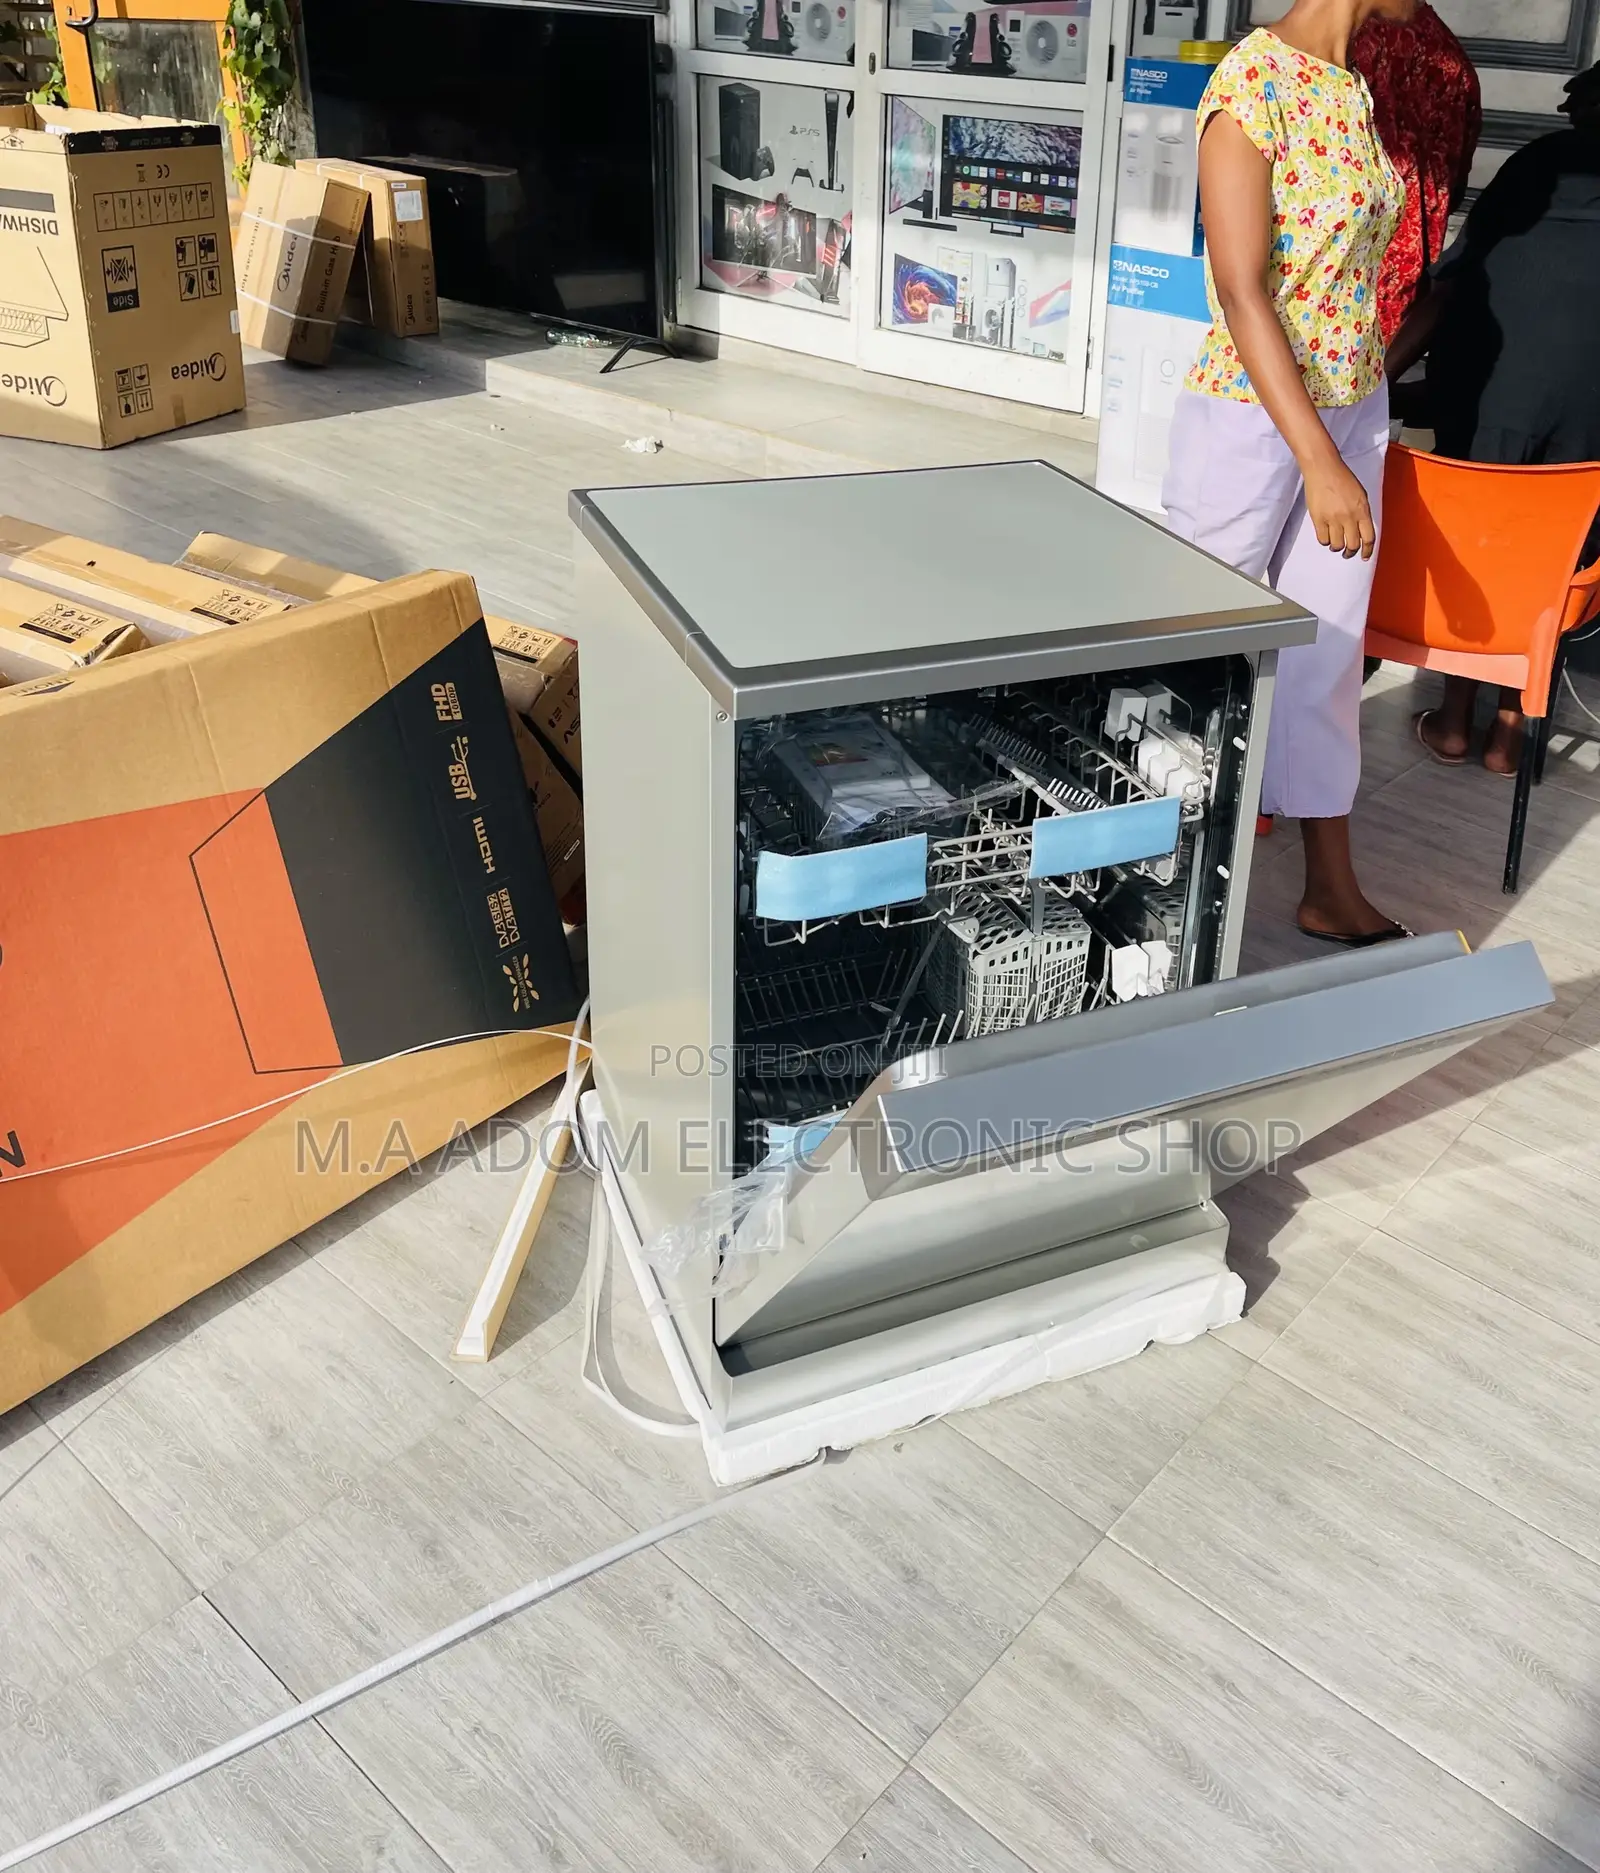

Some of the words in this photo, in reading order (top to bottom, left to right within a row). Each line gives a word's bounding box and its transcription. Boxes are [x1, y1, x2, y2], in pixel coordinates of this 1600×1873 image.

[1136, 69, 1168, 79] NASCO
[0, 214, 59, 236] DISHW
[316, 279, 330, 313] Built-in
[325, 257, 335, 276] Gas
[330, 235, 341, 256] Hb
[1122, 261, 1169, 279] NASCO
[113, 295, 134, 306] Side
[171, 352, 227, 382] Midea
[431, 683, 453, 721] FHD
[447, 685, 460, 716] 1080P
[448, 763, 472, 800] USB
[472, 816, 496, 874] HDMI
